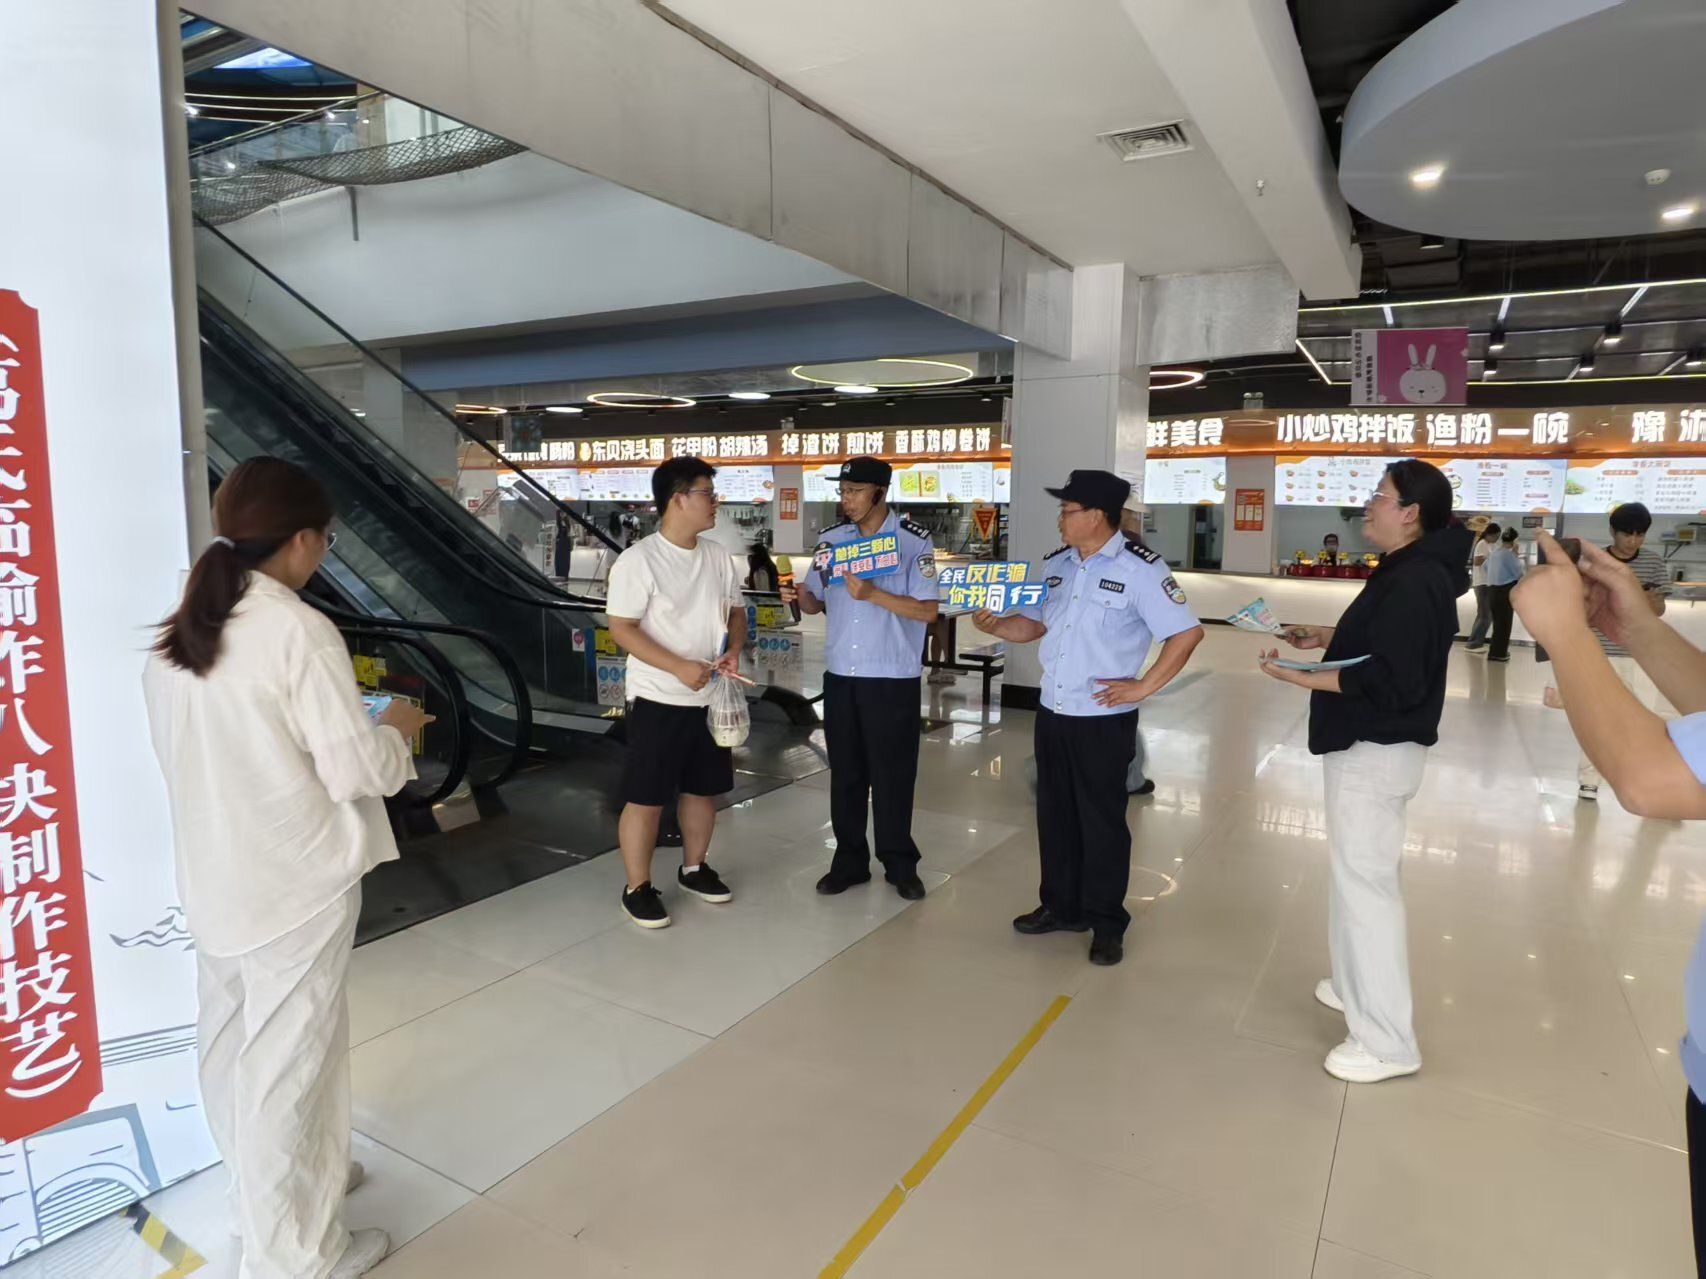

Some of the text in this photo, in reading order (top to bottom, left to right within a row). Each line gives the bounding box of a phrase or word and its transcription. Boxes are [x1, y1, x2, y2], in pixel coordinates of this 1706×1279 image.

[1277, 412, 1570, 445] 小炒鸡拌饭 渔粉一碗
[671, 434, 769, 457] 花甲粉 胡辣汤
[781, 431, 884, 455] 掉渣饼 煎饼
[939, 563, 1028, 584] 全民反诈骗
[949, 584, 1044, 613] 你我同行
